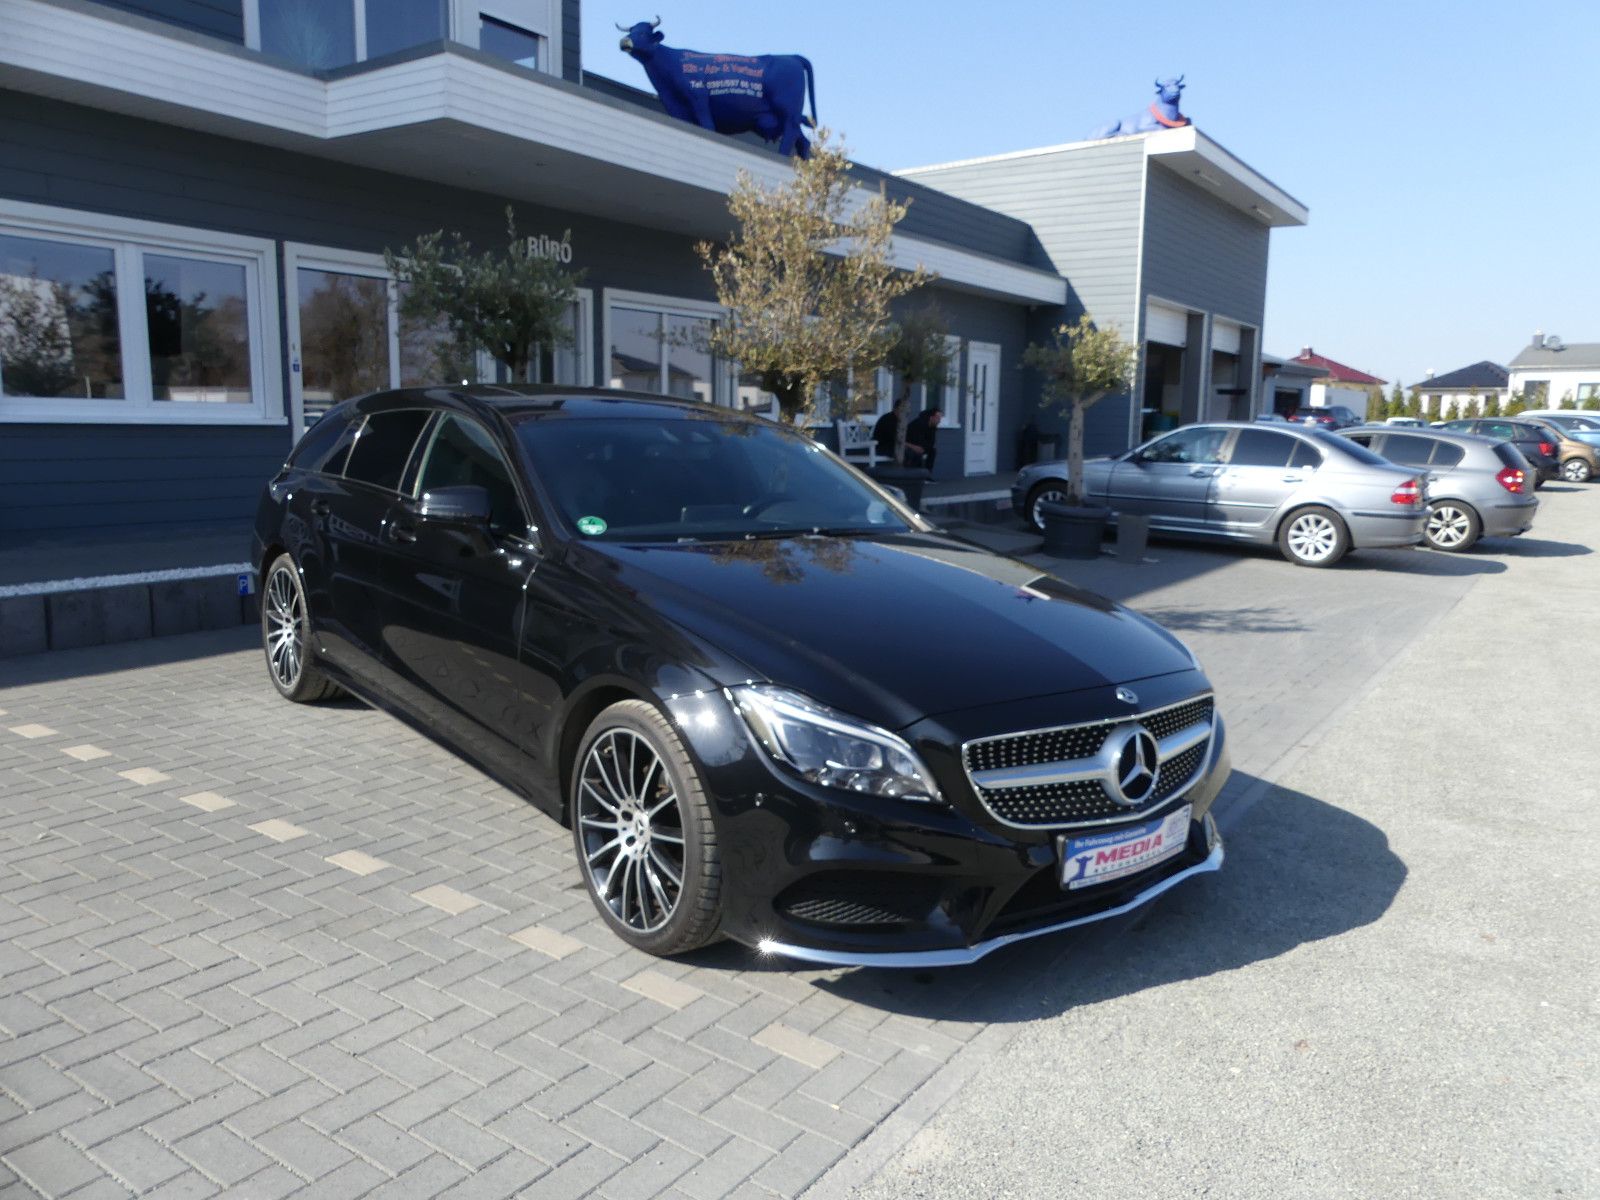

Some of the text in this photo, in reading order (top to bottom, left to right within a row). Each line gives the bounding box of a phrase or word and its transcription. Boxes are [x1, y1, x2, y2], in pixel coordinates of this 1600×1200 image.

[526, 234, 573, 264] BÜRO
[239, 578, 248, 591] P
[1094, 833, 1163, 866] MEDIA
